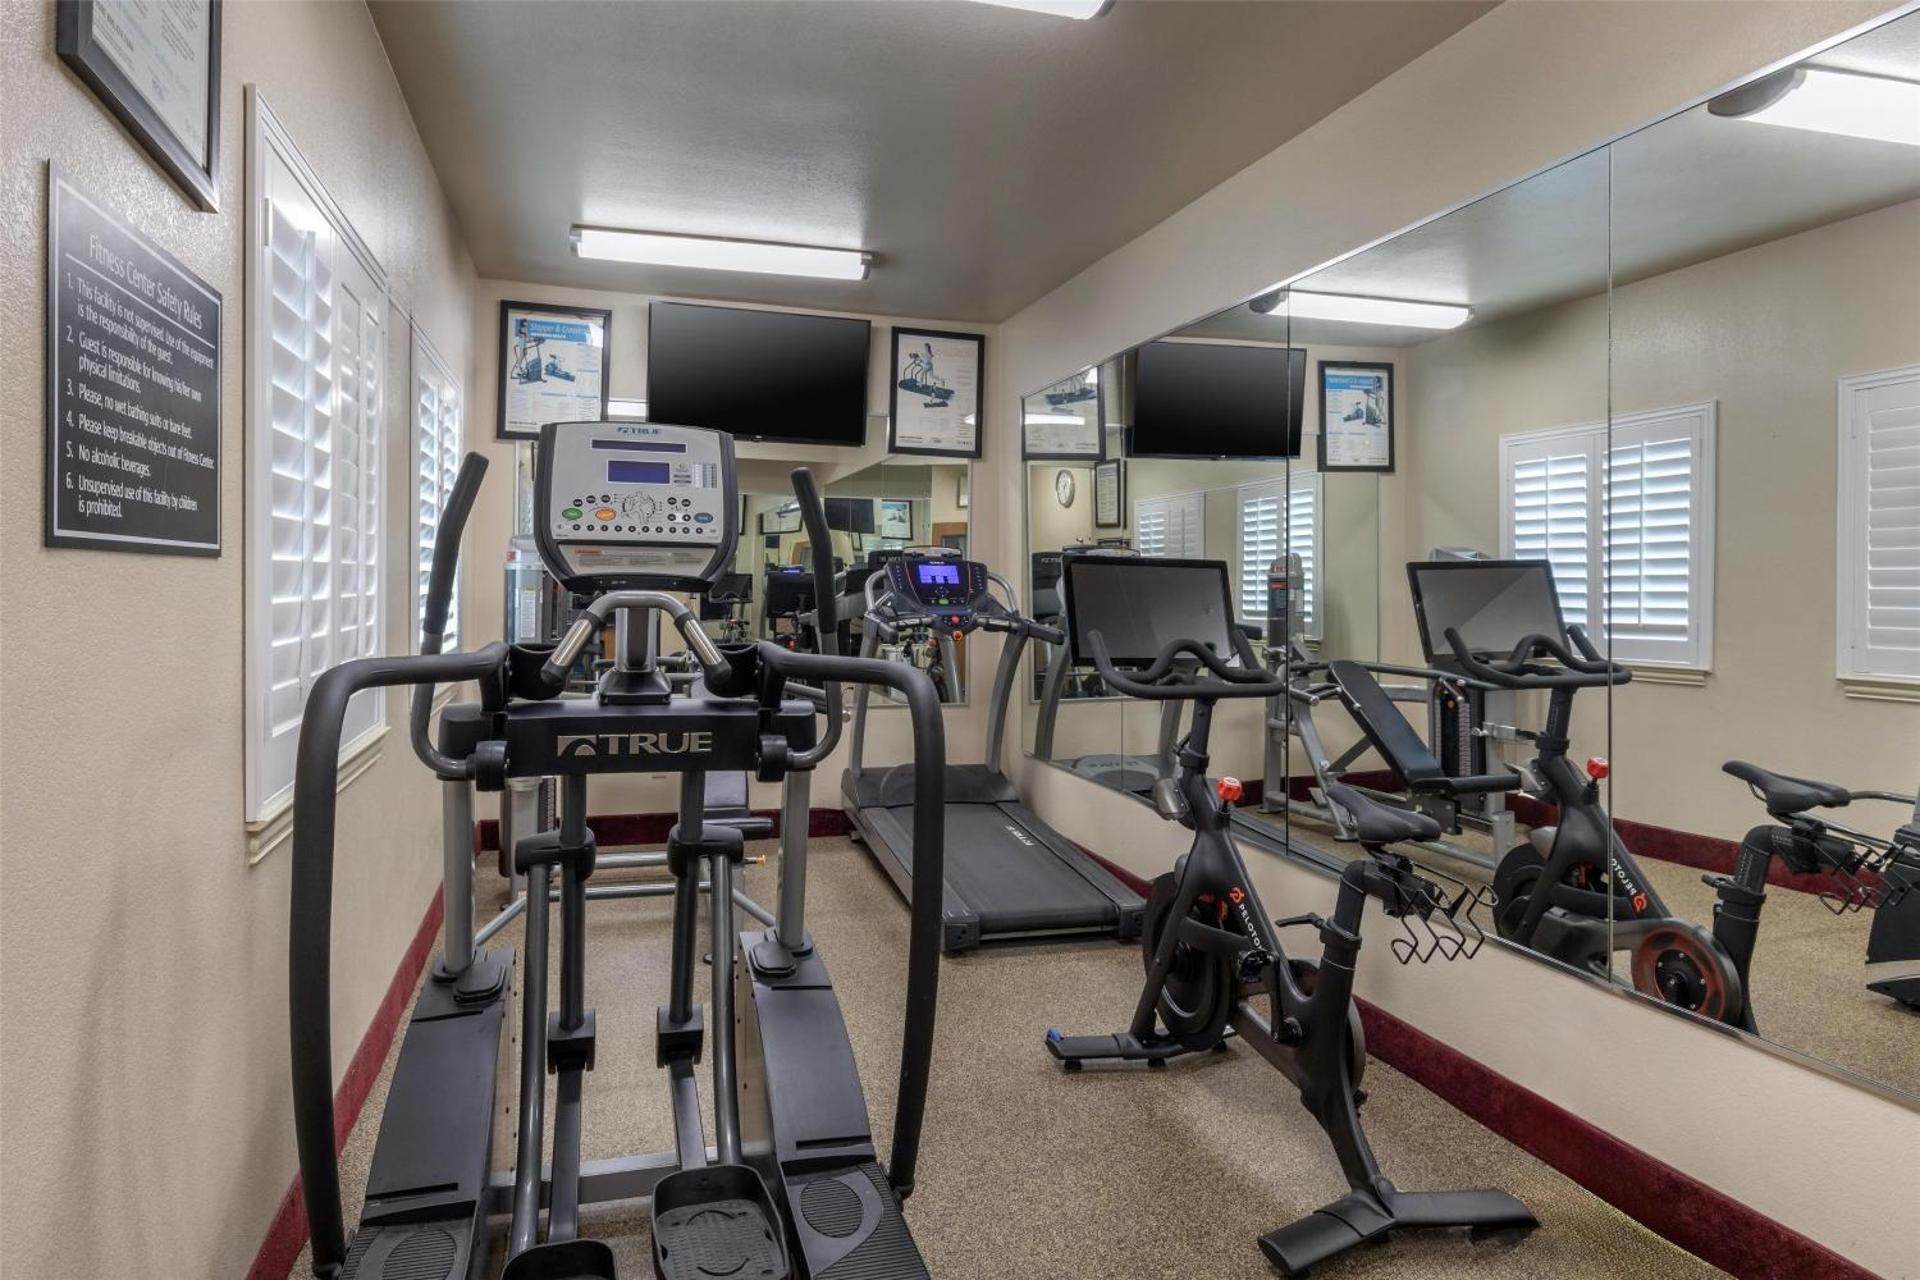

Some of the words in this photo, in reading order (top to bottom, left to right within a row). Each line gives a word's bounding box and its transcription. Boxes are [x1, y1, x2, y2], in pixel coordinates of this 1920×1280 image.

[67, 272, 74, 290] 1.
[78, 277, 92, 300] This
[94, 286, 117, 318] facility
[118, 298, 123, 318] is
[124, 307, 134, 325] not
[89, 232, 125, 278] Fitness
[126, 260, 155, 298] Center
[157, 281, 182, 320] Safety
[183, 300, 202, 329] Rules
[78, 298, 84, 318] is
[85, 303, 98, 325] the
[99, 313, 139, 349] responsibility
[140, 334, 147, 350] of
[147, 339, 156, 357] the
[79, 330, 100, 356] Guest
[101, 340, 107, 358] is
[108, 348, 141, 375] responsible
[142, 362, 151, 379] for
[152, 365, 174, 393] knowing
[79, 353, 107, 378] physical
[66, 378, 74, 396] 3.
[104, 396, 114, 411] no
[115, 400, 127, 416] wet
[127, 400, 148, 426] bathing
[149, 411, 162, 429] suits
[162, 418, 169, 431] or
[169, 417, 181, 435] bare
[66, 410, 74, 428] 4.
[79, 413, 102, 436] Please
[103, 420, 118, 444] keep
[119, 425, 147, 449] breakable
[148, 436, 167, 456] objects
[168, 445, 176, 458] out
[66, 440, 74, 458] 5.
[79, 443, 91, 462] No
[92, 446, 120, 470] alcoholic
[122, 453, 152, 479] beverages.
[66, 472, 74, 489] 6.
[79, 473, 124, 498] Unsupervised
[124, 486, 135, 500] use
[135, 486, 142, 501] of
[143, 487, 153, 504] this
[154, 489, 171, 510] facility
[172, 492, 178, 511] by
[79, 494, 86, 513] is
[86, 498, 122, 518] prohibited.
[599, 731, 713, 755] TRUE
